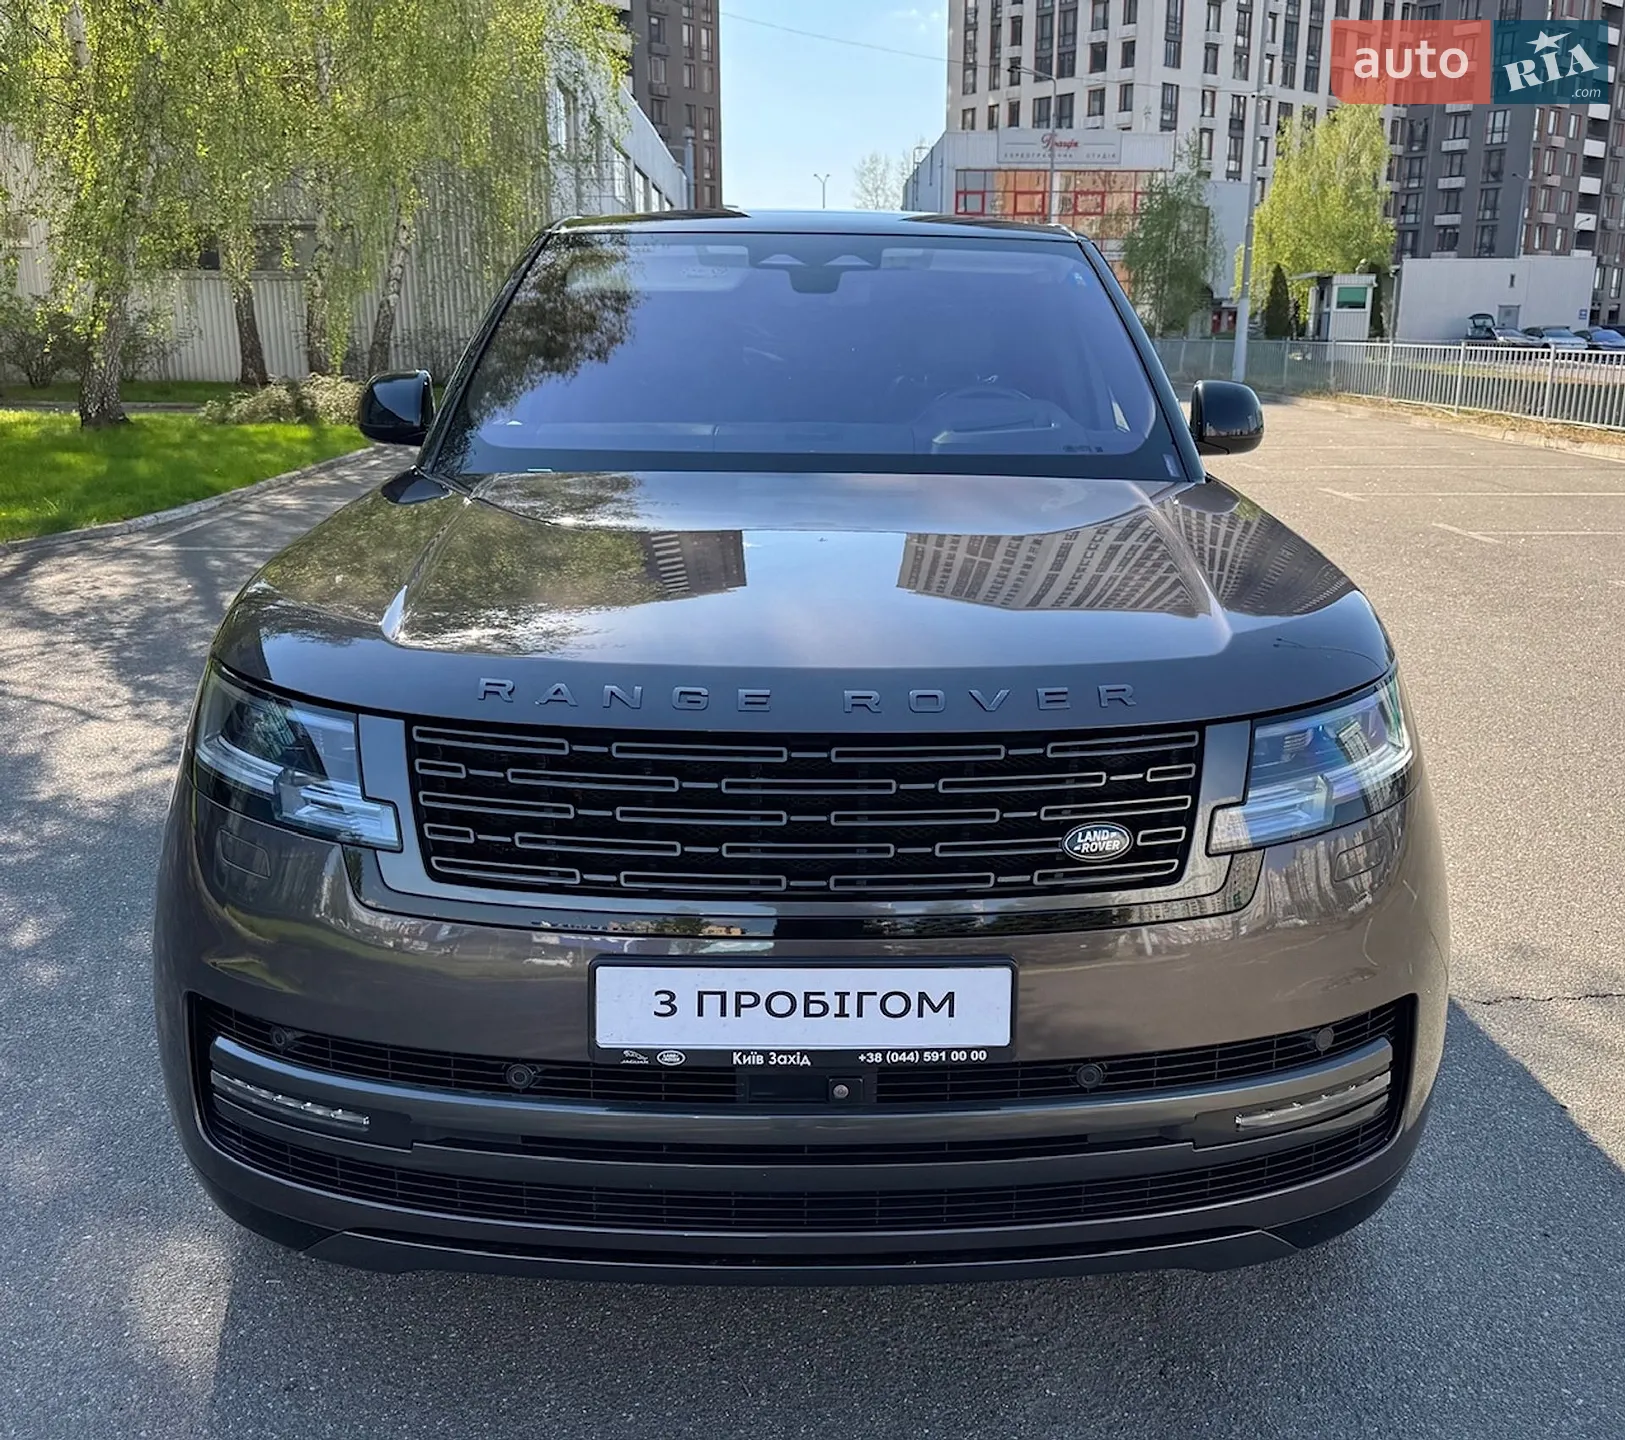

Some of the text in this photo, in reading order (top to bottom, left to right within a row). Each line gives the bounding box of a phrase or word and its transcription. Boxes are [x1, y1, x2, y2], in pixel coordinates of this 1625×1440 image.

[477, 677, 1137, 714] RANGE ROVER
[1077, 829, 1110, 843] LAND
[1081, 840, 1120, 853] ROVER
[696, 990, 956, 1019] ПРОБІГОМ
[732, 1051, 811, 1067] Київ Захід
[858, 1050, 987, 1064] +38 (044) 591 00 00
